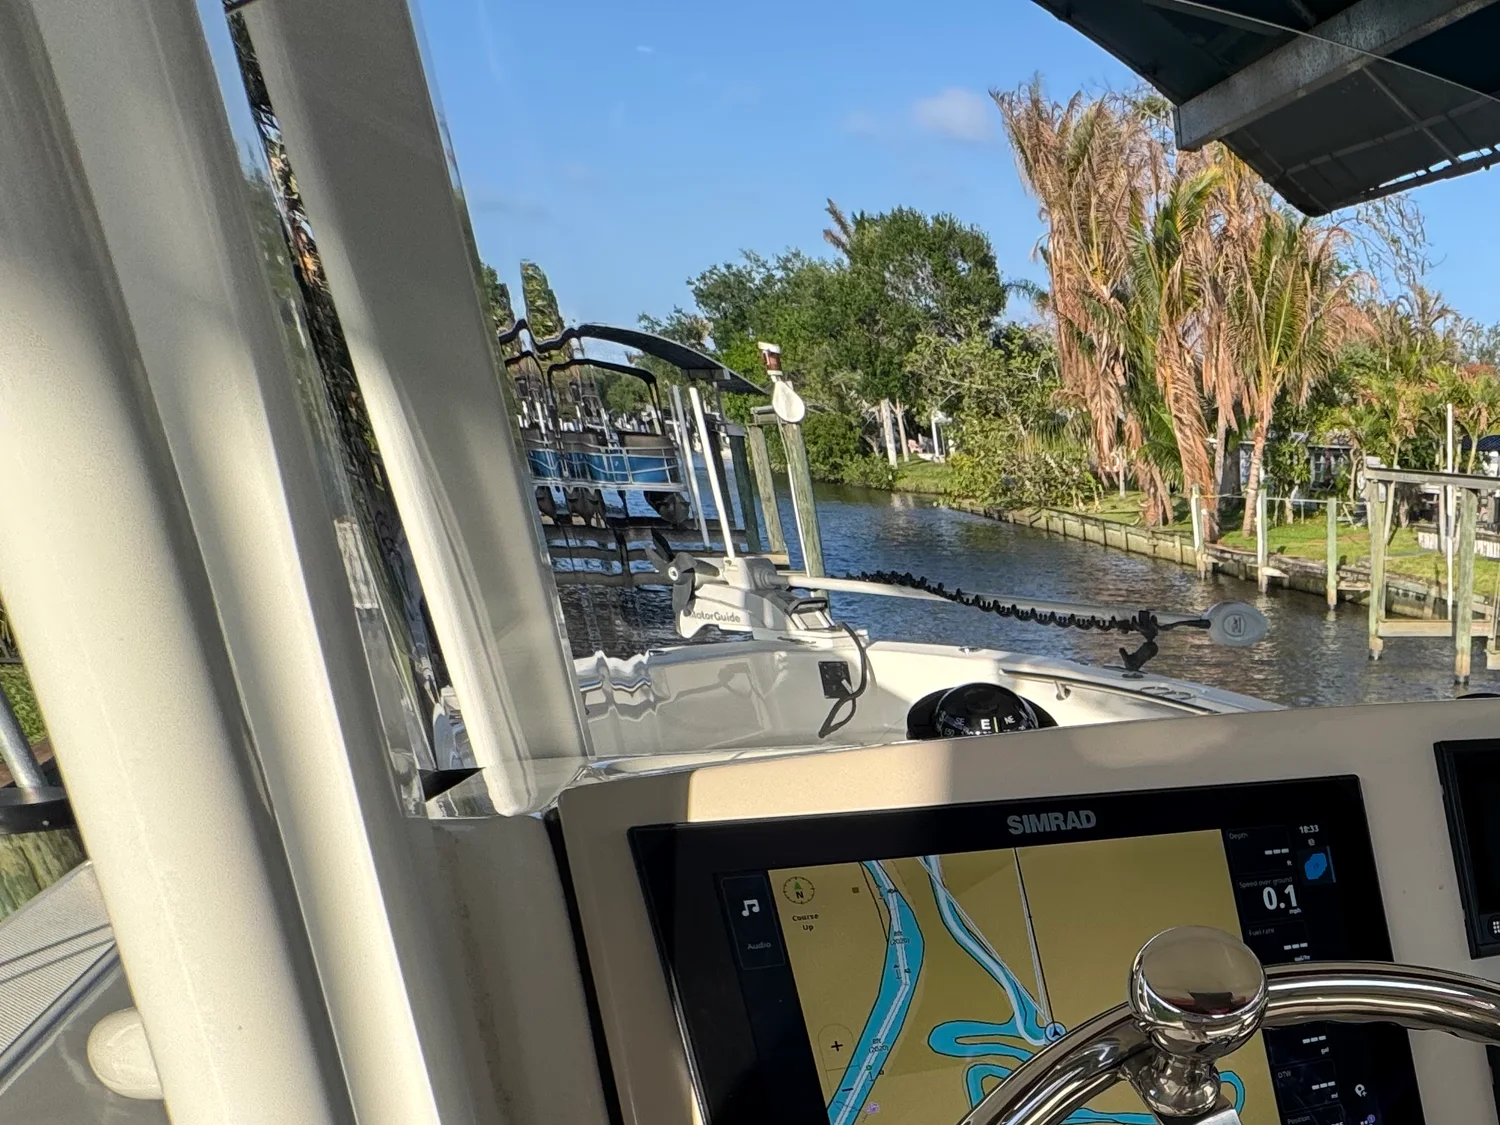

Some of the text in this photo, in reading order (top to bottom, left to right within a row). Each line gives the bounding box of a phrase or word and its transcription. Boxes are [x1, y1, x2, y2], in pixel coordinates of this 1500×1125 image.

[981, 718, 991, 730] E
[1004, 715, 1016, 725] NE
[1007, 810, 1096, 835] SIMRAD
[1299, 824, 1319, 834] 18:33
[1229, 831, 1248, 840] Depth
[1239, 880, 1257, 888] Speed
[1273, 876, 1293, 886] ground
[796, 891, 804, 899] N
[1263, 884, 1297, 910] 0.1
[792, 913, 819, 922] Course
[802, 924, 814, 932] Up
[748, 942, 772, 950] Audio
[1288, 1115, 1310, 1124] Position
